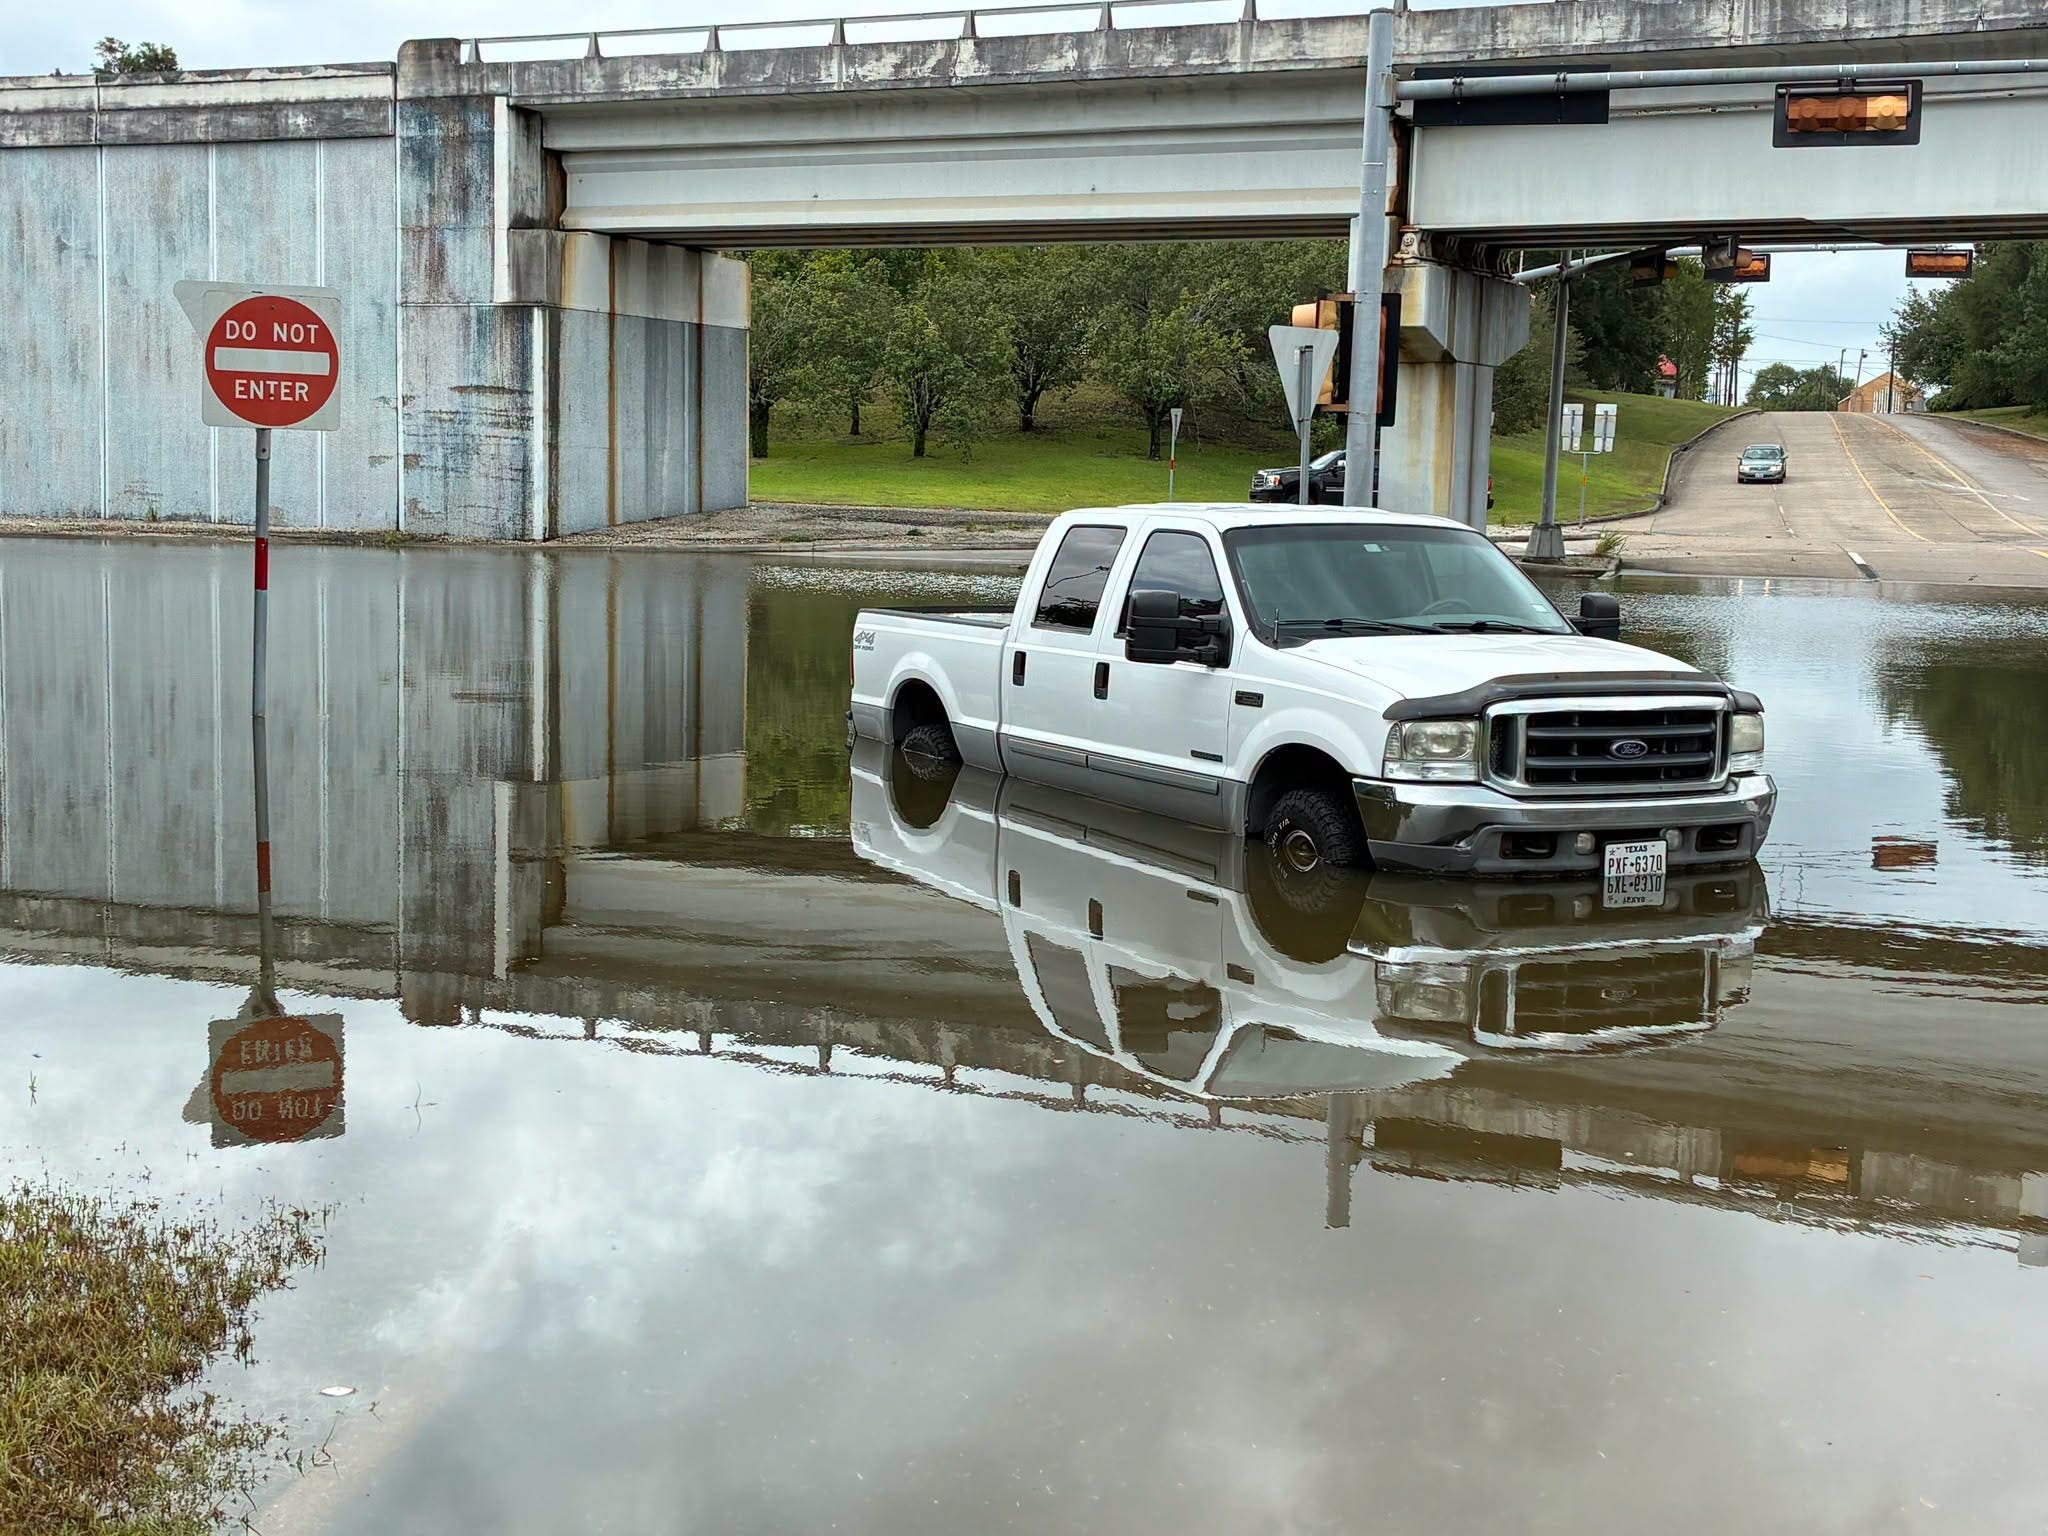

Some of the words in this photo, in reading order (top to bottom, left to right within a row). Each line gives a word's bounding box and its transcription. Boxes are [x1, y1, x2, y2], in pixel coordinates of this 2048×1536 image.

[226, 320, 257, 341] DO
[273, 323, 319, 344] NOT
[235, 379, 309, 402] ENTER
[1625, 845, 1648, 853] TEXAS
